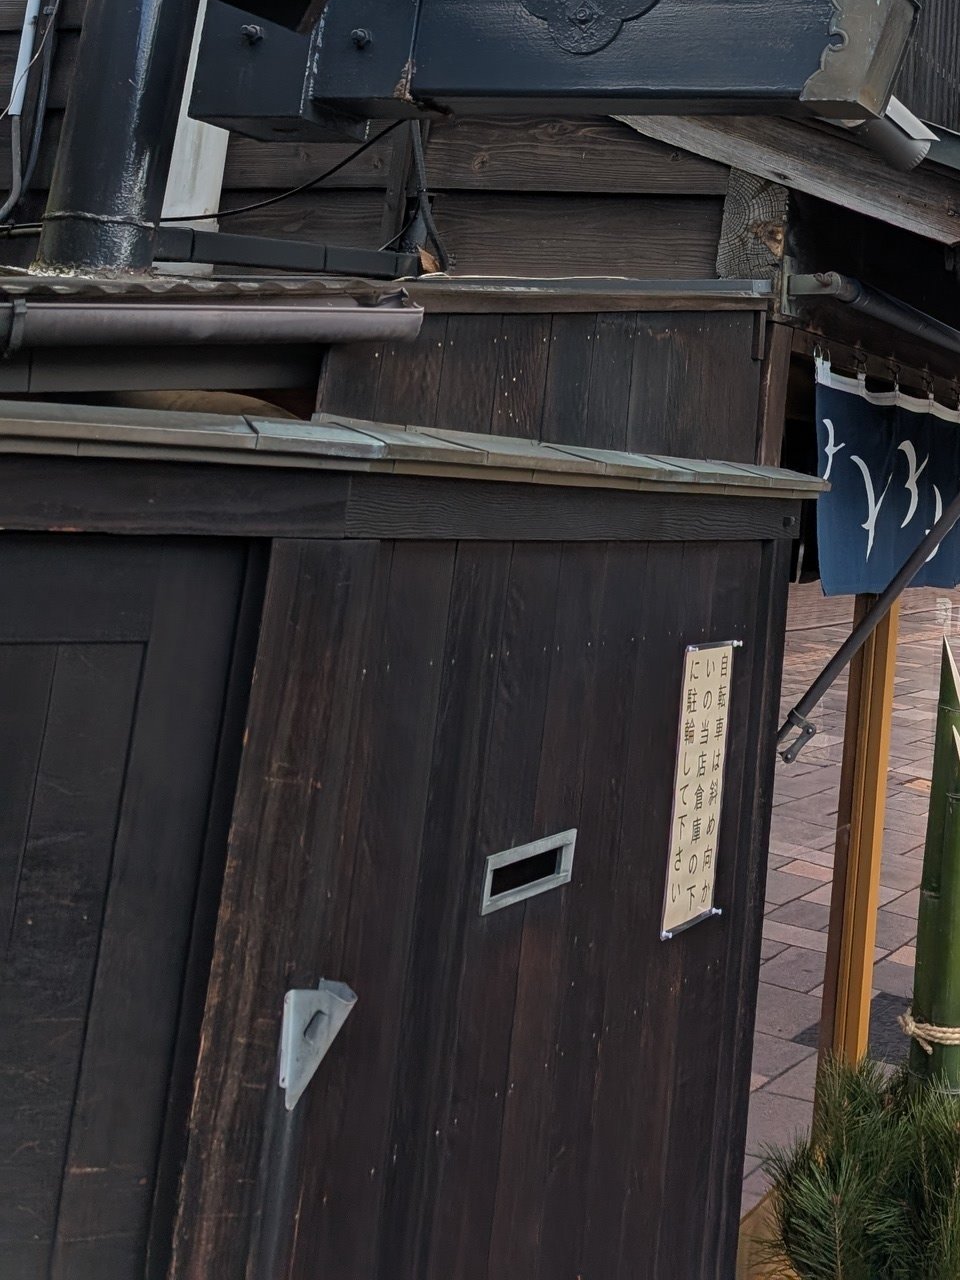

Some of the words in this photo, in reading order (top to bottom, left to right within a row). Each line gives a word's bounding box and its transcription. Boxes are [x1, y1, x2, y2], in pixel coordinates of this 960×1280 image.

[671, 660, 699, 903] に駐輪して下さい
[686, 663, 716, 911] いの当店倉庫の下
[700, 653, 729, 904] 自転車は斜め向か
